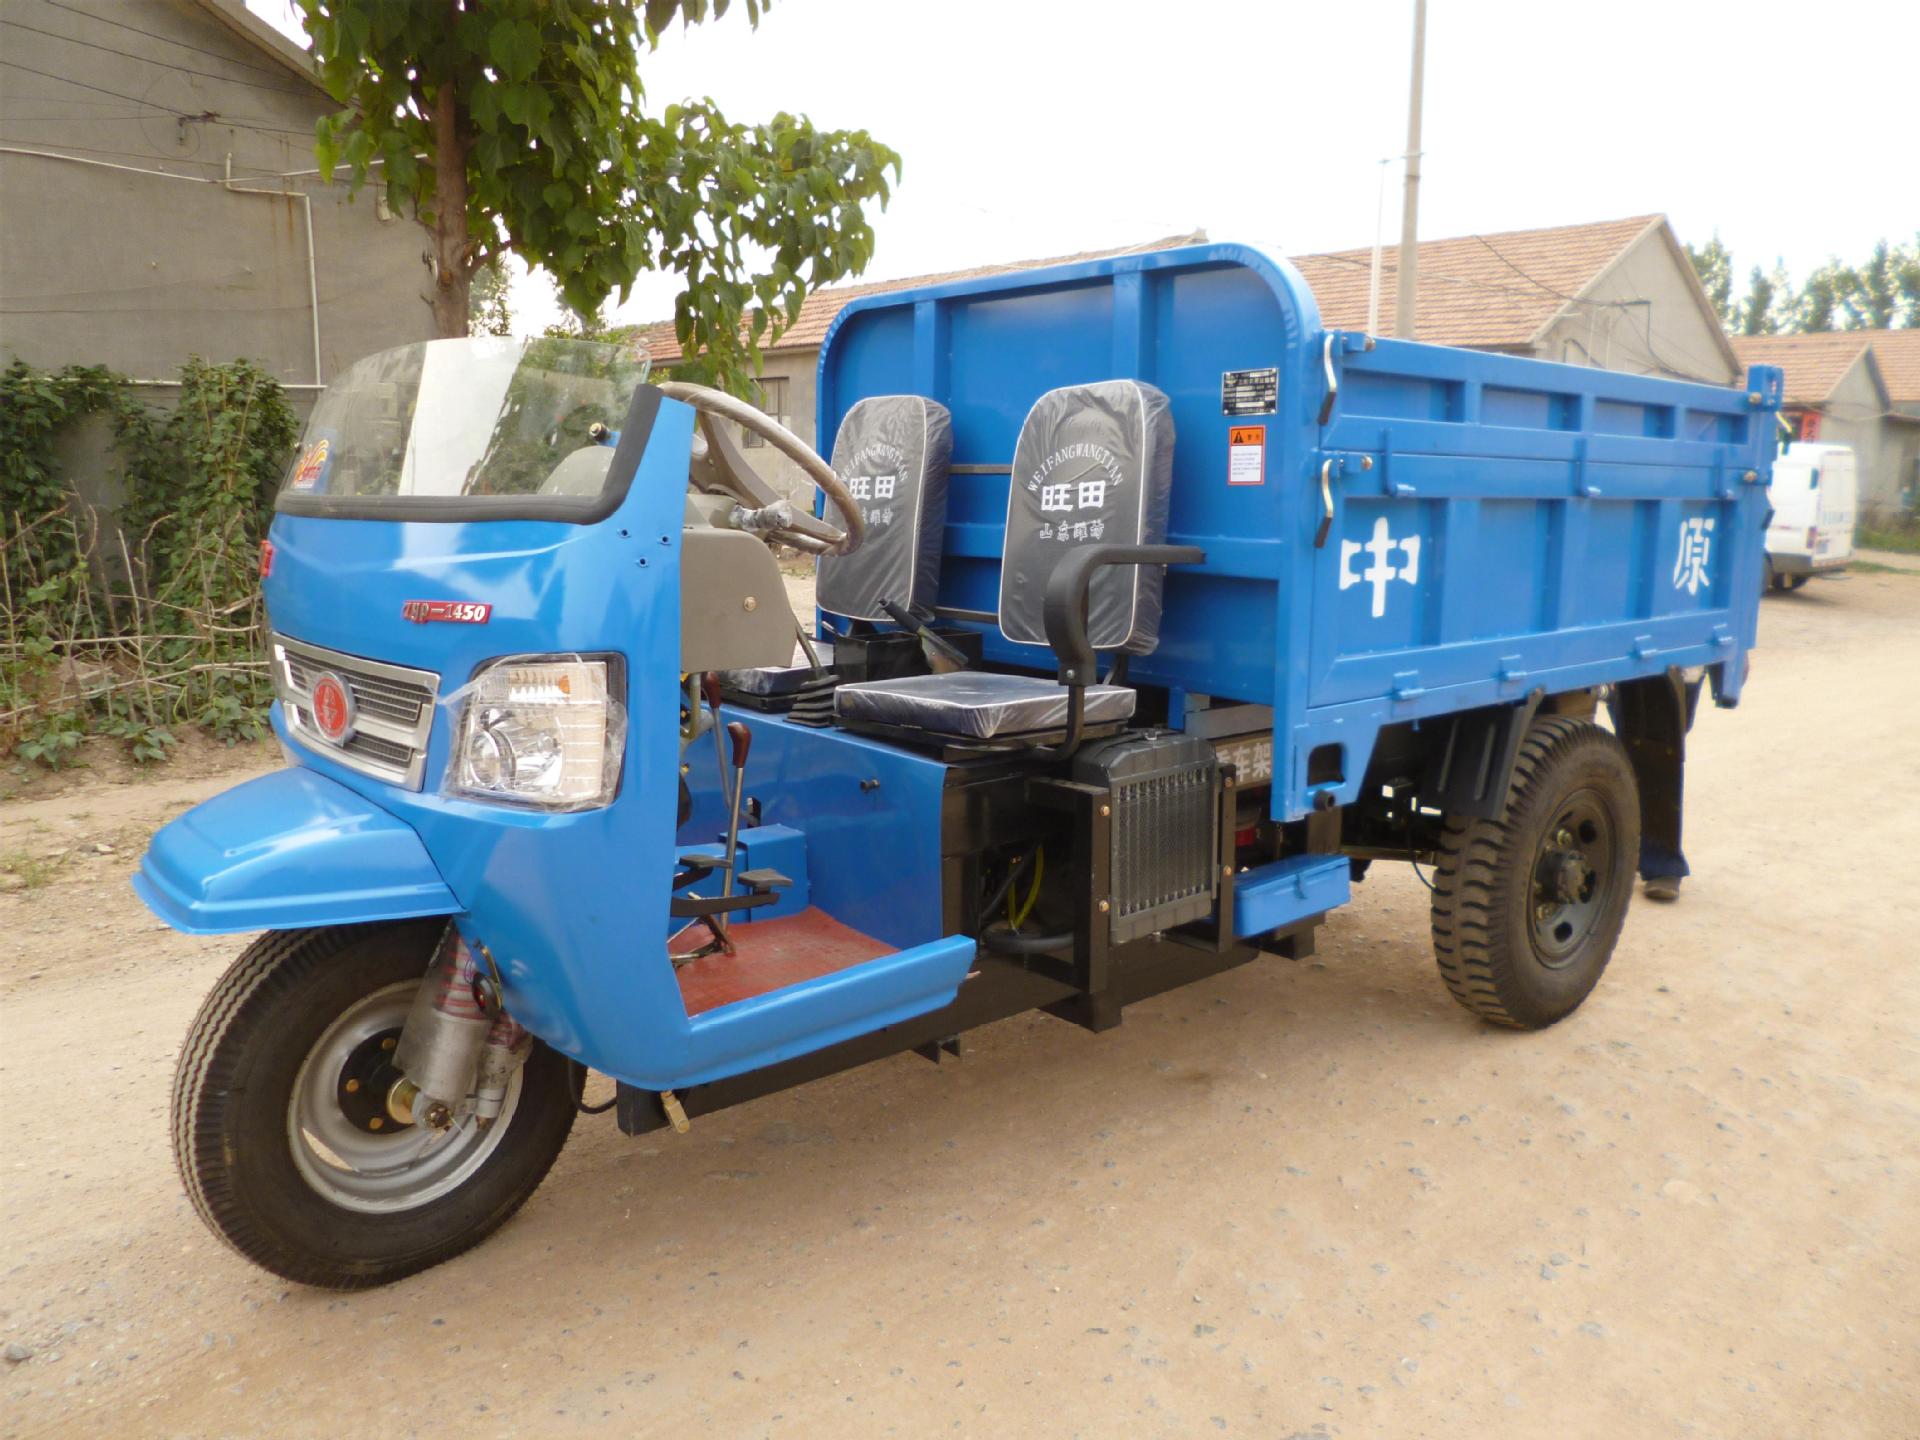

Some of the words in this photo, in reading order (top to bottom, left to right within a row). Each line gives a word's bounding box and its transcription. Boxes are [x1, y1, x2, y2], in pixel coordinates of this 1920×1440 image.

[849, 475, 896, 501] 旺田
[1027, 443, 1124, 492] WEIFANGWANGTIAN
[1040, 479, 1107, 512] 旺田
[1338, 515, 1421, 619] 中
[1672, 516, 1716, 597] 原
